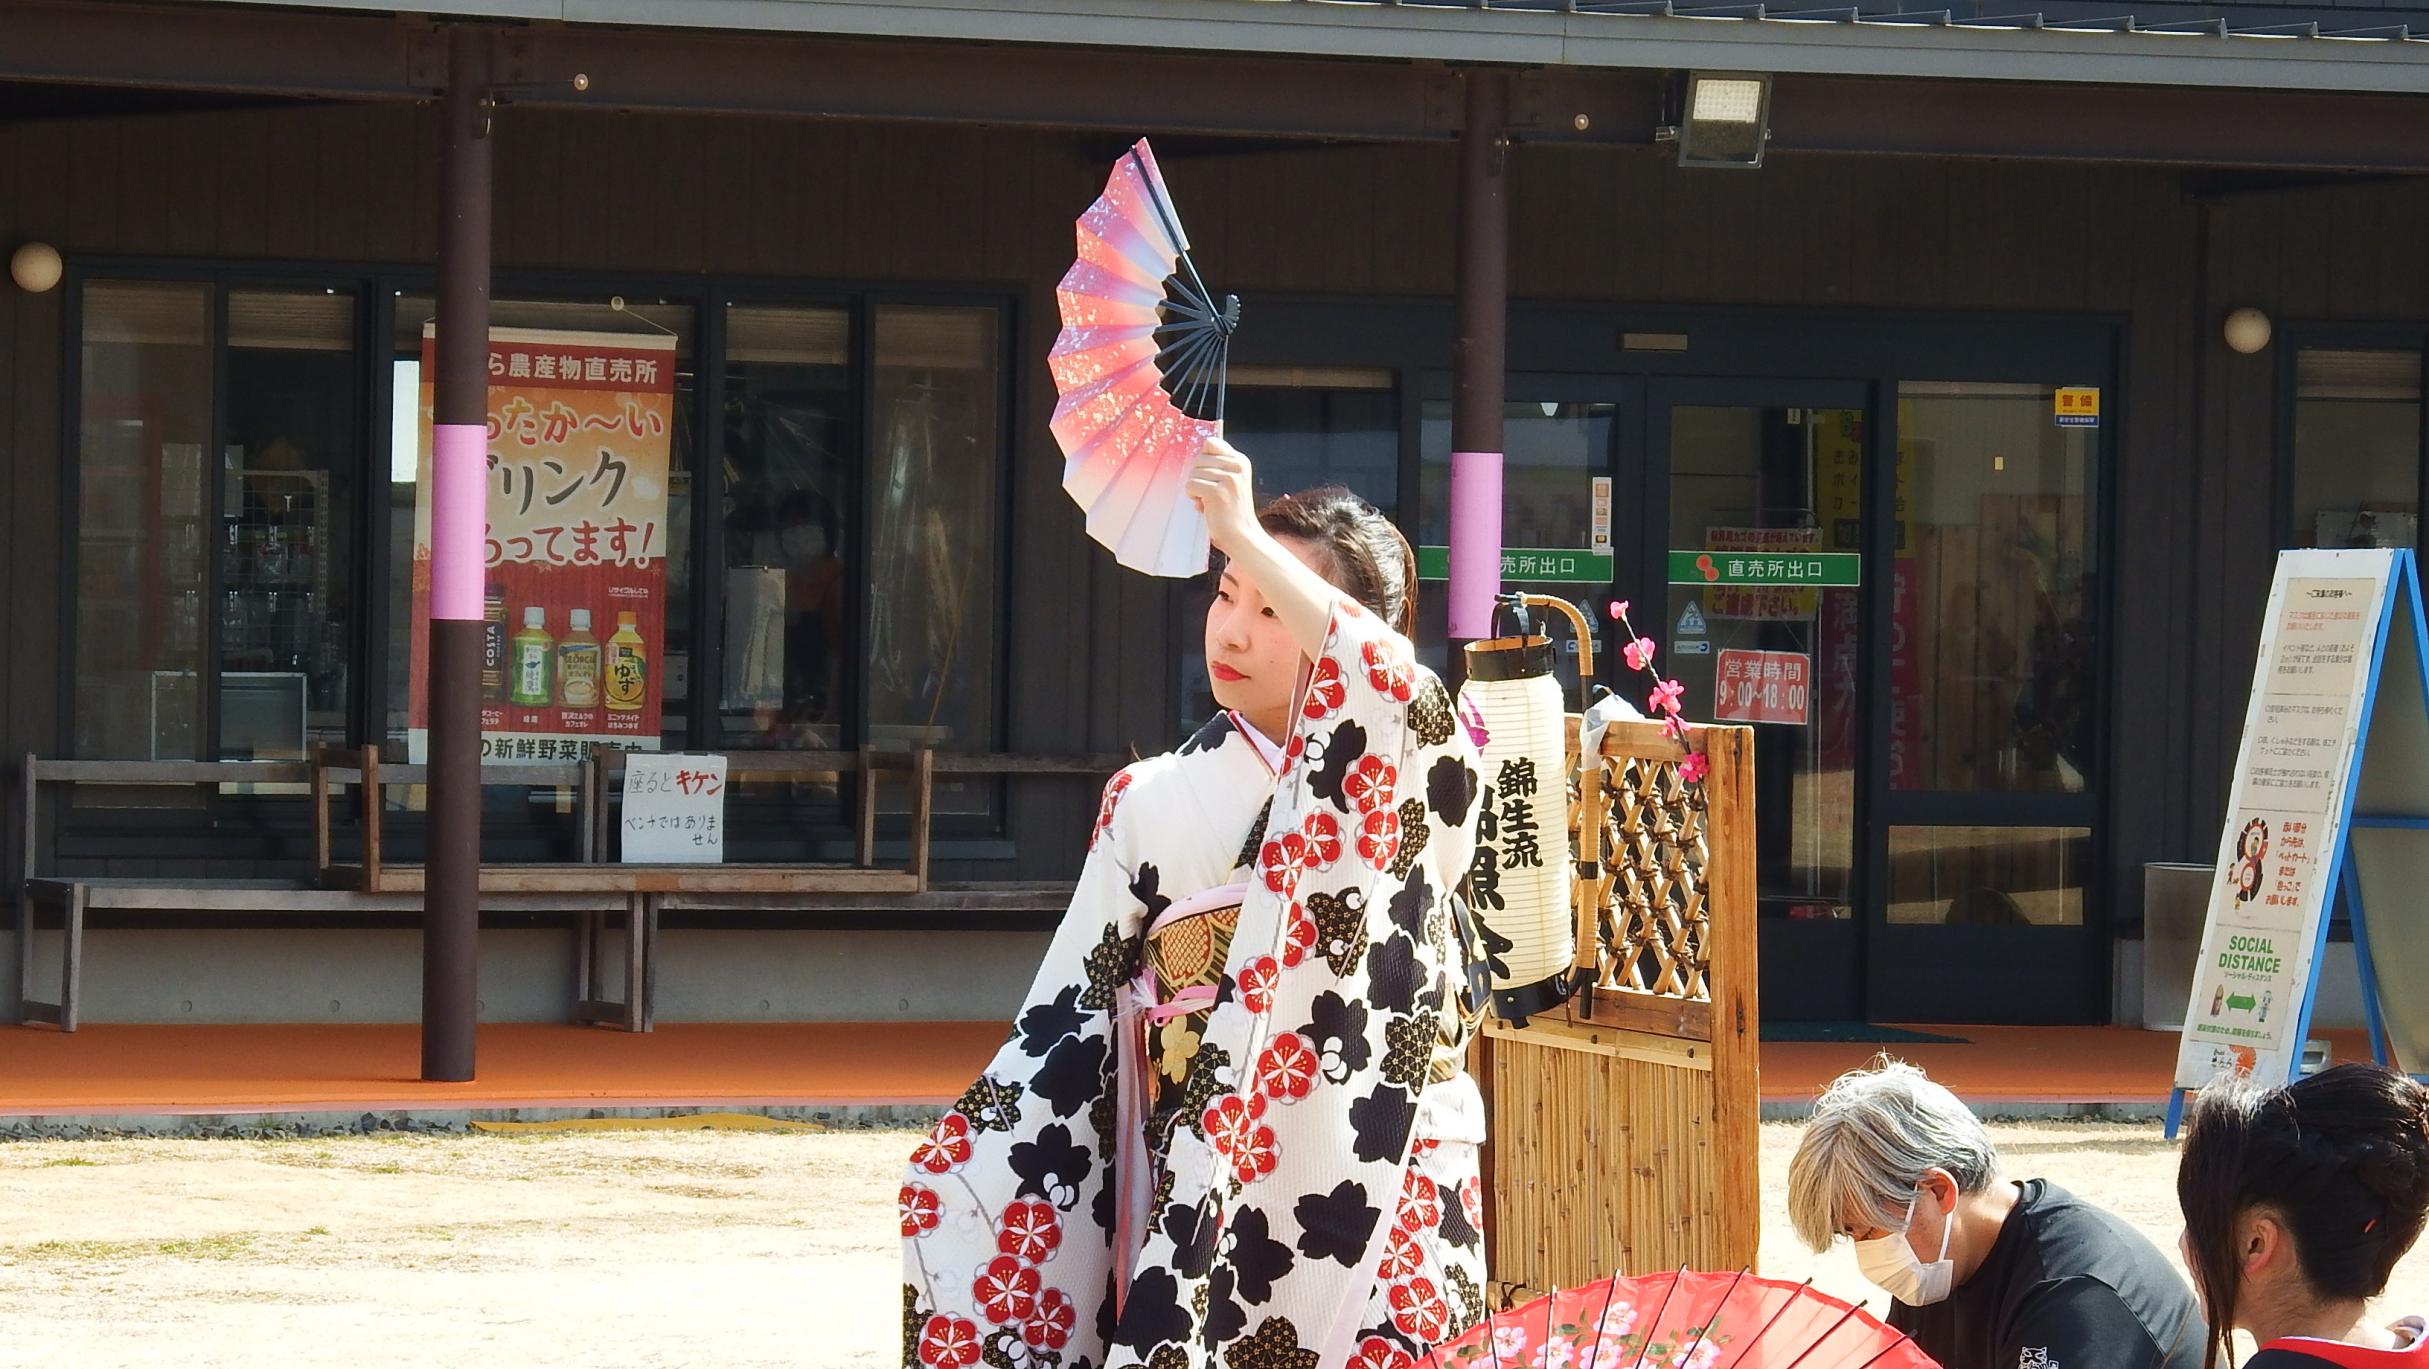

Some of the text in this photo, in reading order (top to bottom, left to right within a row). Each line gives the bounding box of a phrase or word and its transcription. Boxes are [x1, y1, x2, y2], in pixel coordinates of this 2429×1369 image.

[487, 451, 627, 516] リンク
[1500, 555, 1575, 575] 売所出口
[1727, 559, 1822, 578] 直売所出口
[486, 625, 497, 667] COSTA
[1725, 658, 1802, 682] 営業時間
[1497, 756, 1544, 870] 錦生流
[2228, 935, 2274, 955] SOCIAL
[2217, 953, 2281, 974] DISTANCE
